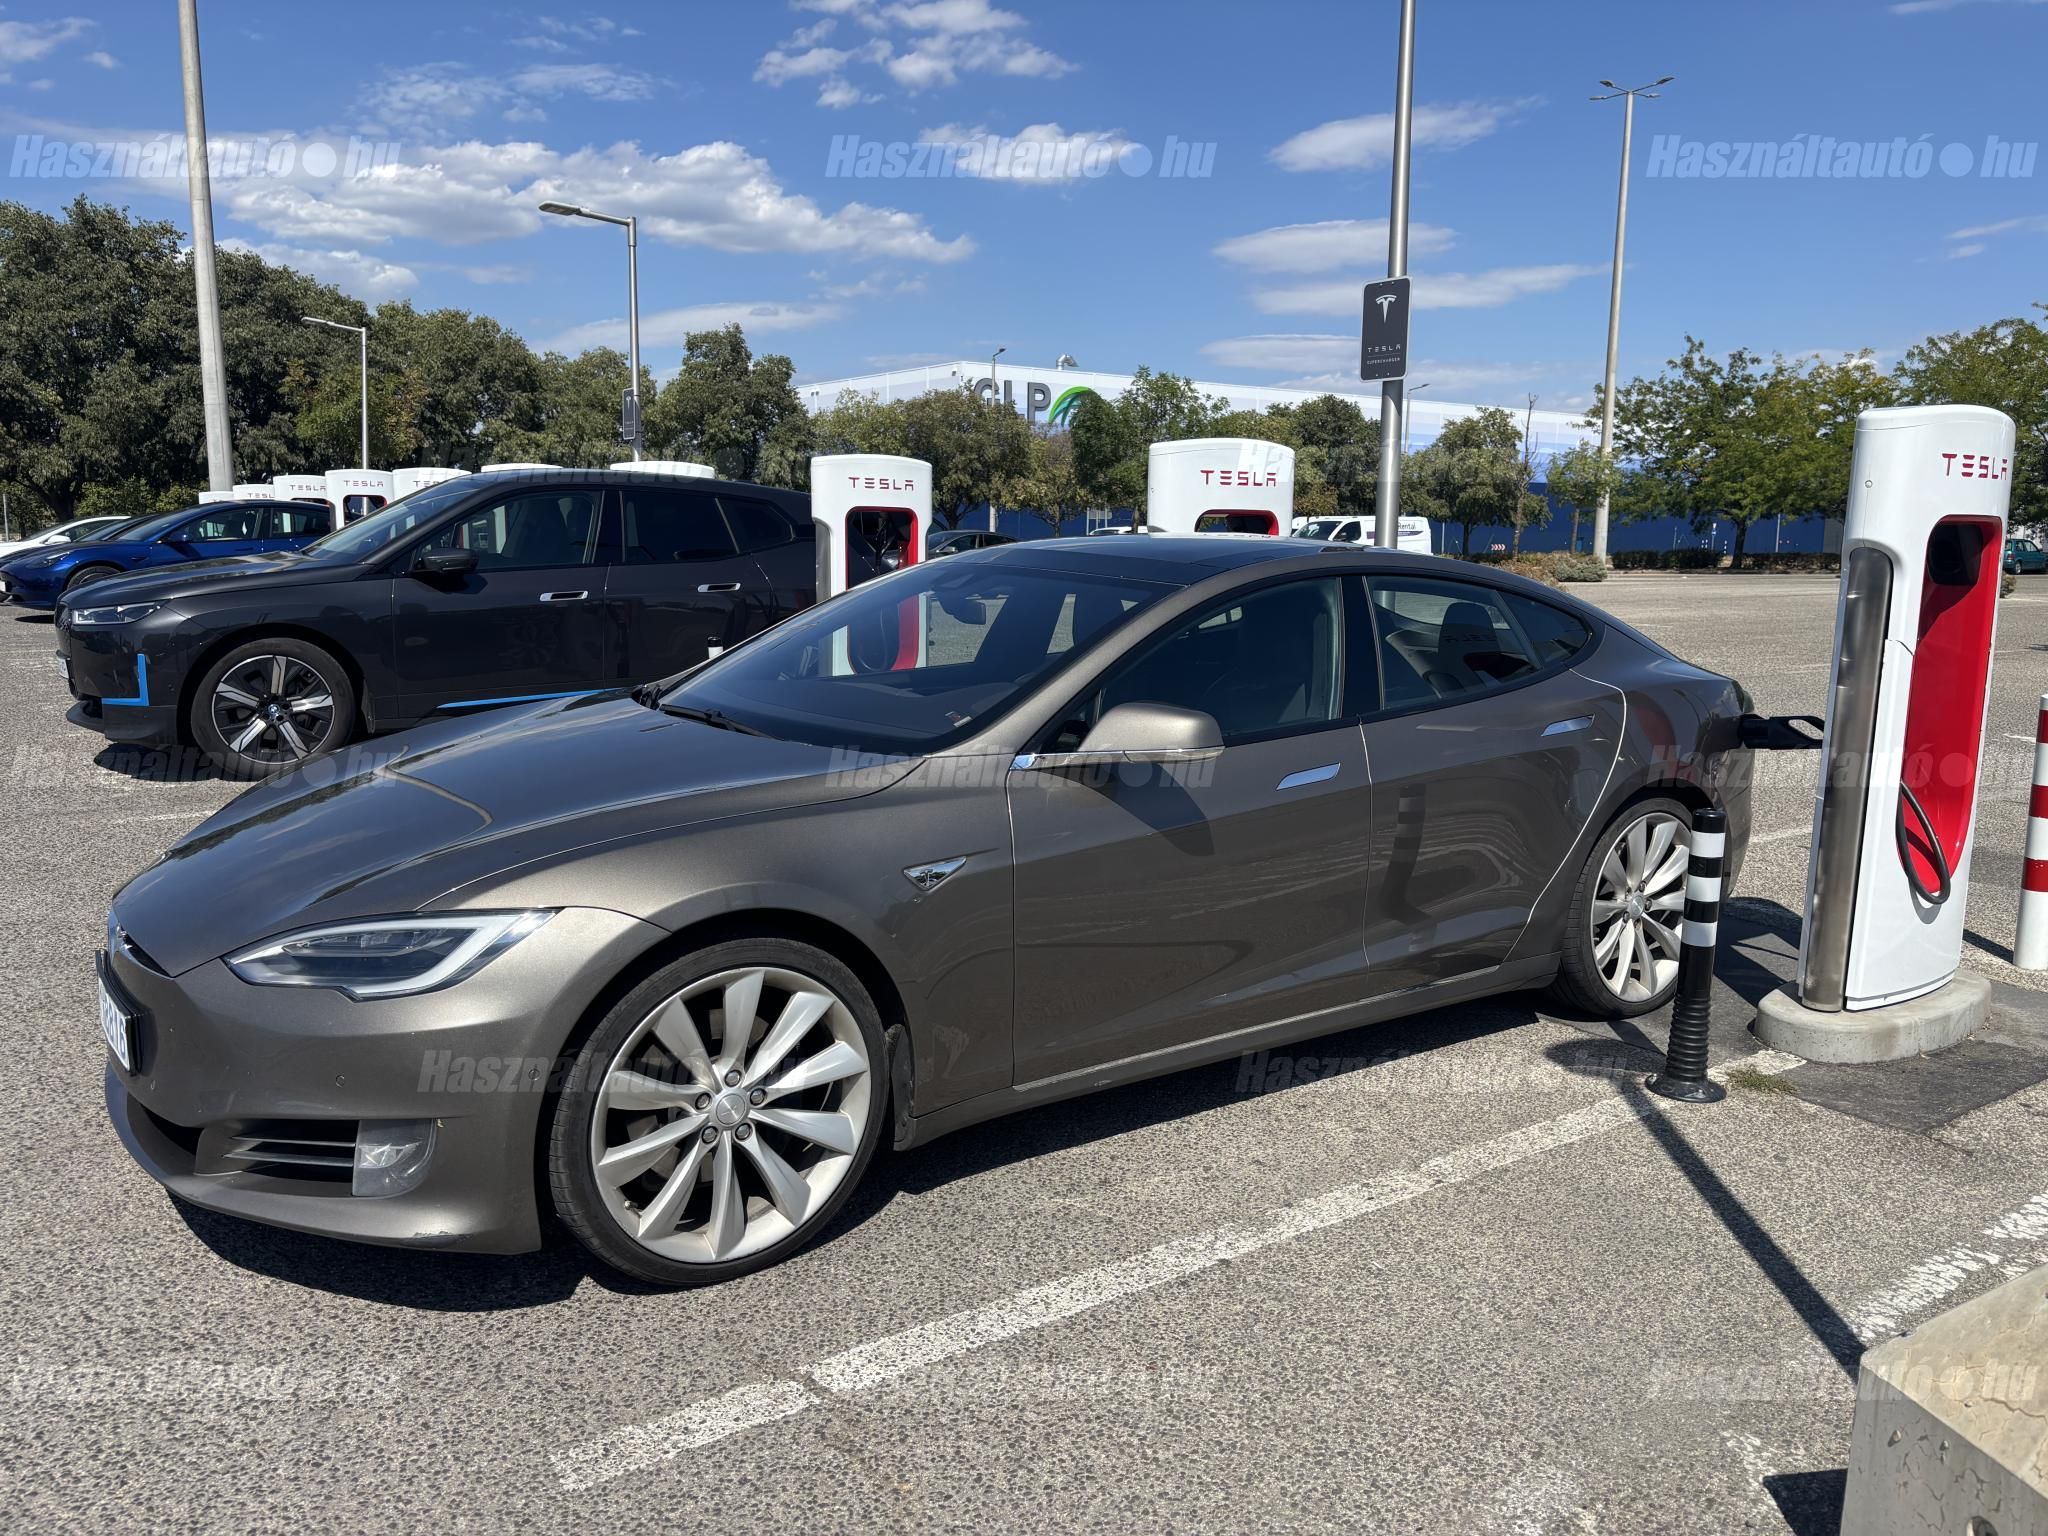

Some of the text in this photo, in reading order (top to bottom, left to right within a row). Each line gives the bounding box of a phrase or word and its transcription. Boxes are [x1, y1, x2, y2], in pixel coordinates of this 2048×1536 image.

[1367, 344, 1401, 353] TESLA
[1942, 453, 2007, 480] TESLA
[848, 477, 914, 491] TESLA
[1201, 469, 1277, 487] TESLA
